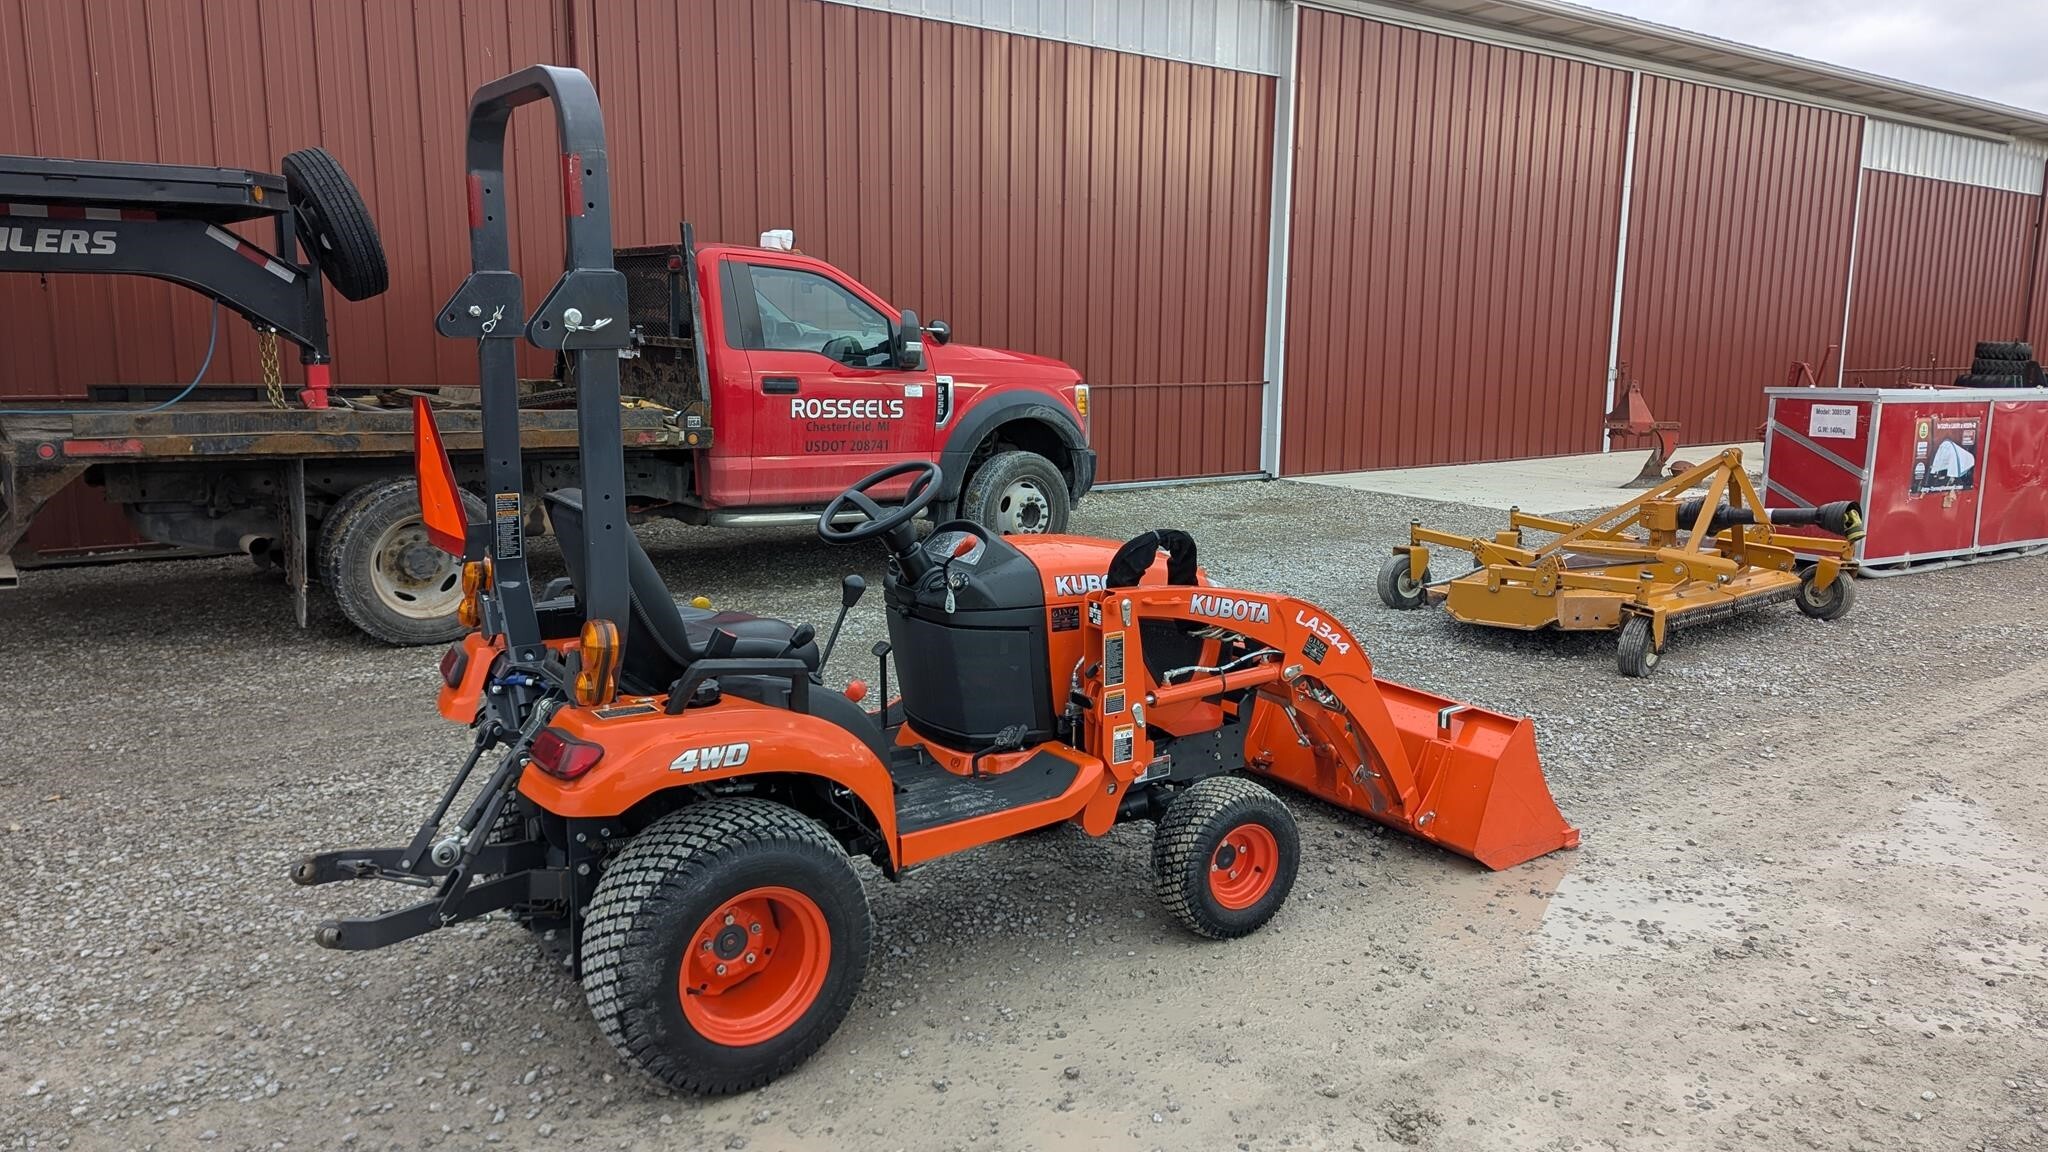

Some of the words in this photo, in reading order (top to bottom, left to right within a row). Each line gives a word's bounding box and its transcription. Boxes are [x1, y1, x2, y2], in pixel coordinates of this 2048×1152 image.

[791, 398, 904, 419] ROSSEEL'S
[805, 440, 847, 453] USDOT
[850, 439, 889, 452] 208741
[1190, 594, 1270, 624] KUBOTA
[1296, 610, 1350, 655] LA344
[669, 742, 750, 773] 4WD
